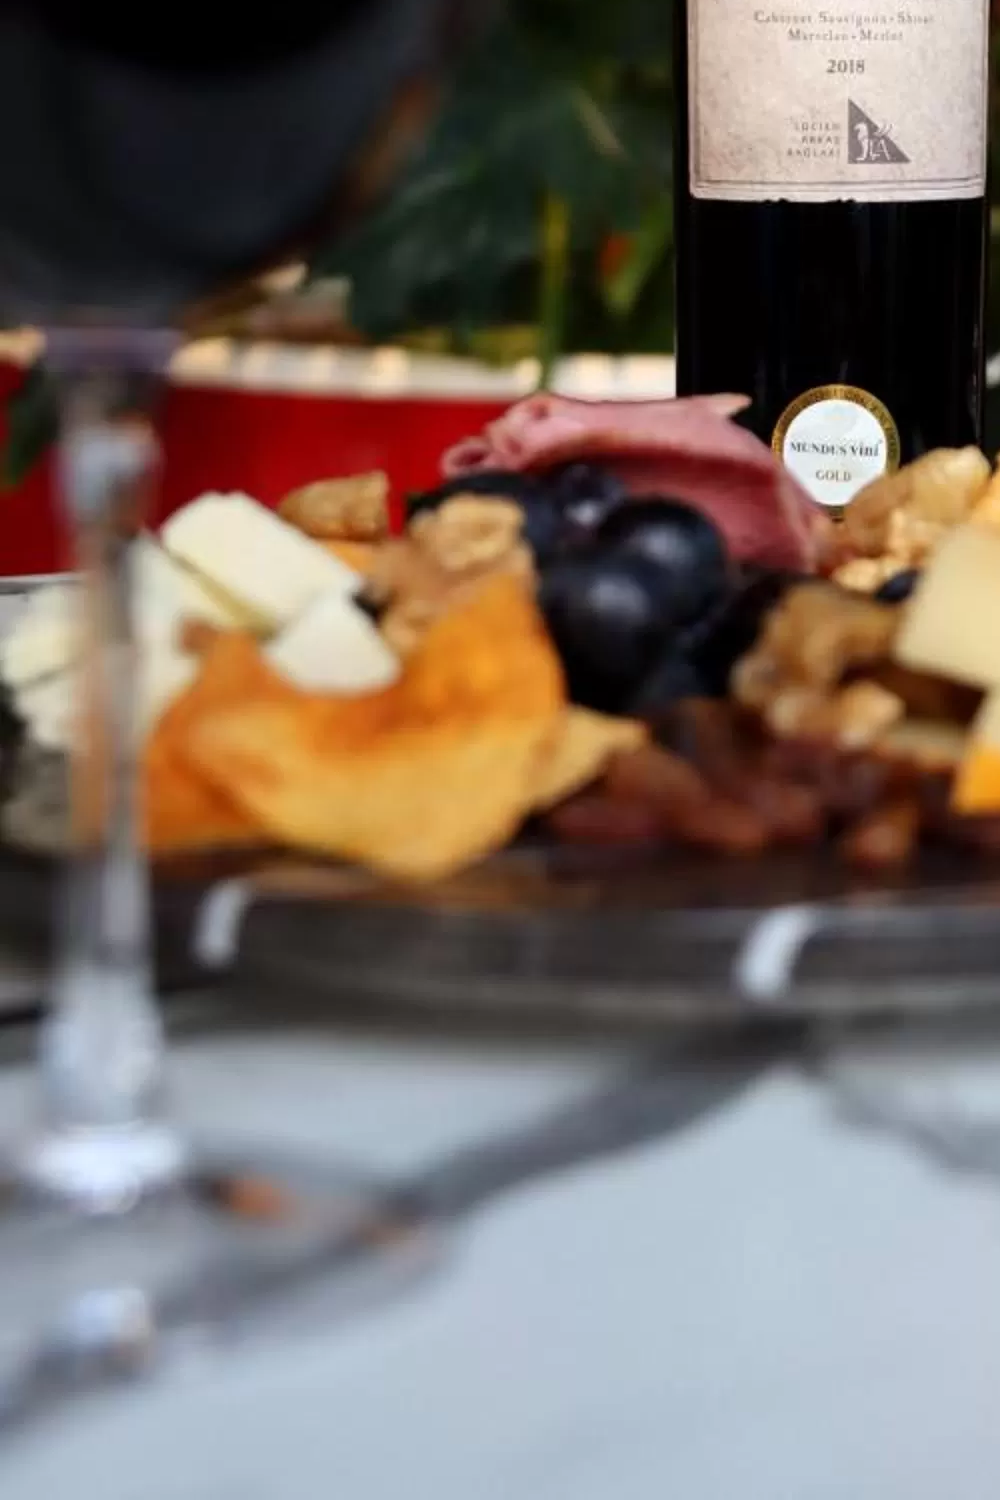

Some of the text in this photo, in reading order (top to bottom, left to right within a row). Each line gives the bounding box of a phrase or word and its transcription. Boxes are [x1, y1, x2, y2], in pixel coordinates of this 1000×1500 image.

[754, 10, 812, 24] Cabernet
[826, 59, 866, 74] 2018
[790, 441, 847, 457] MUNDUS
[815, 468, 853, 482] GOLD
